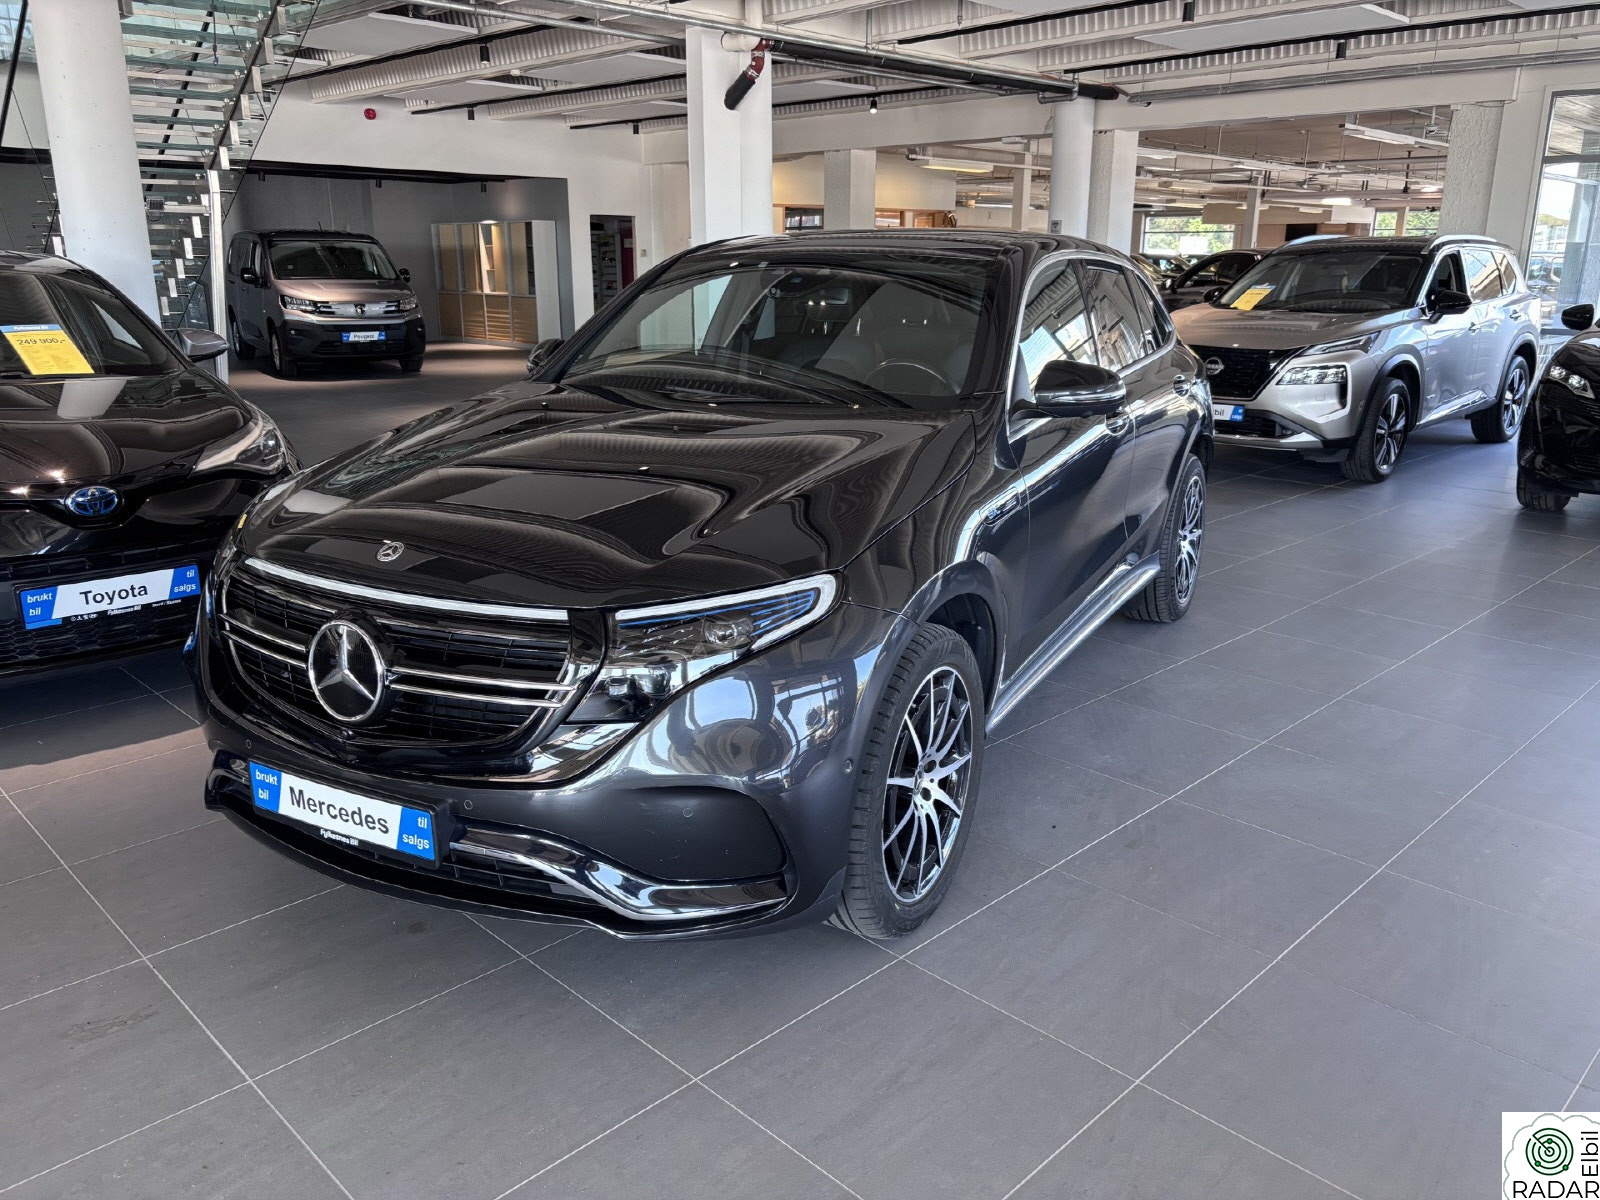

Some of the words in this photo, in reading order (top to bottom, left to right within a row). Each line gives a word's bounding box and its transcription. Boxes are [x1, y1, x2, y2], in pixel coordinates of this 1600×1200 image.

[187, 570, 195, 578] til
[173, 583, 196, 593] salgs
[27, 592, 53, 603] brukt
[79, 584, 148, 606] Toyota
[29, 607, 41, 616] bil
[256, 769, 278, 785] brukt
[258, 788, 269, 800] bil
[289, 786, 389, 834] Mercedes
[417, 816, 427, 829] til
[402, 833, 429, 850] salgs
